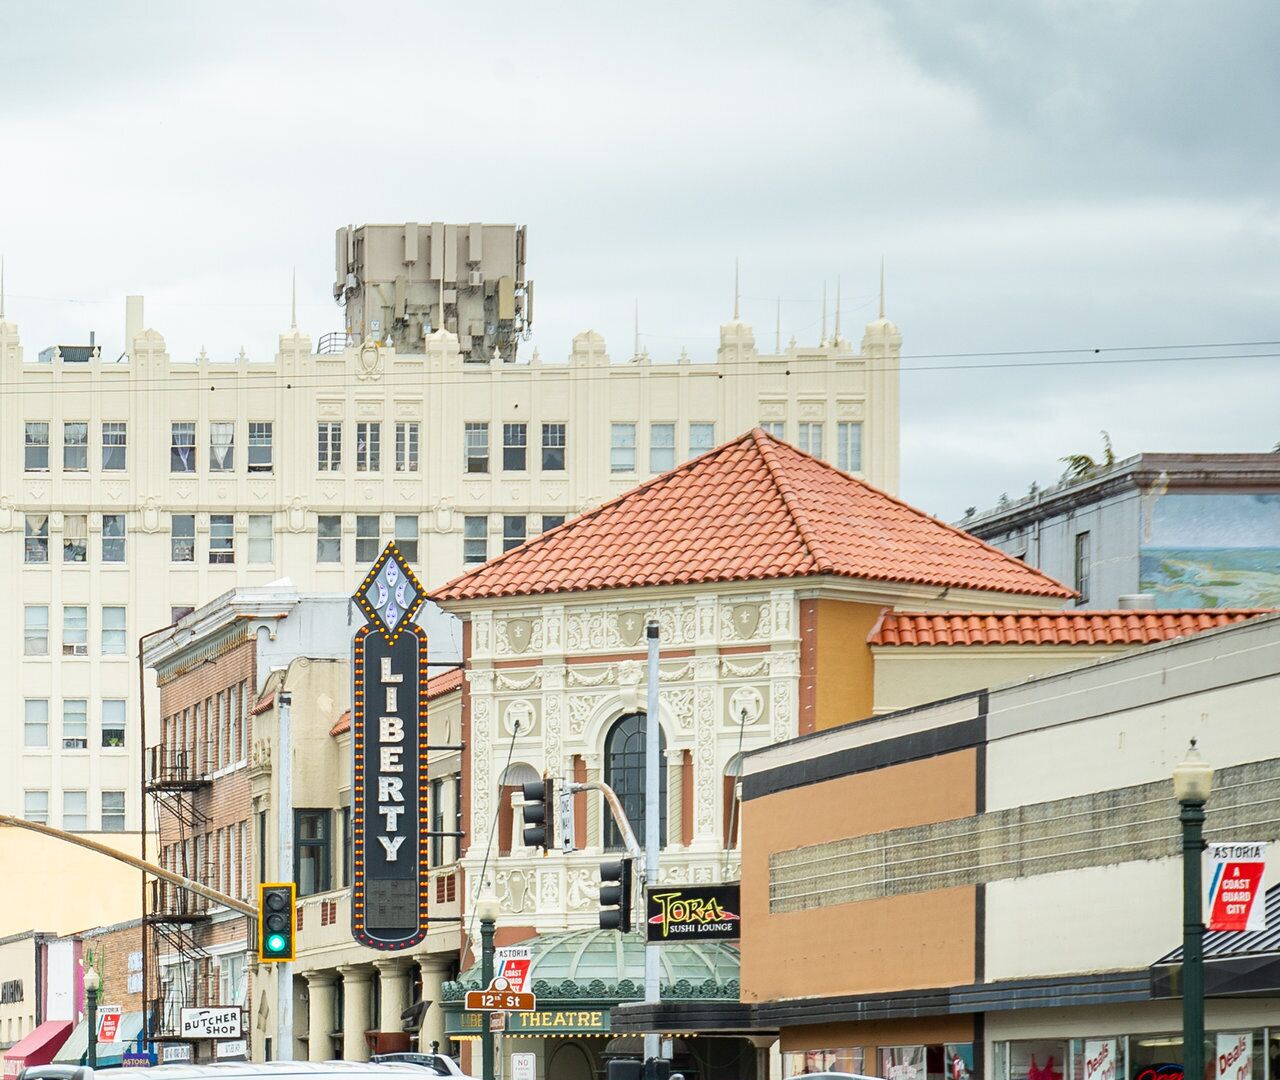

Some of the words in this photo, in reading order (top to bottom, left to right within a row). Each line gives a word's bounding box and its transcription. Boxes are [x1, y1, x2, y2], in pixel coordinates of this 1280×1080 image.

[378, 656, 406, 863] LIBERTY
[1213, 845, 1262, 859] ASTORIA
[1232, 866, 1240, 878] A
[1222, 878, 1251, 890] COAST
[1226, 903, 1247, 915] CITY
[669, 924, 695, 933] SUSHI
[697, 922, 733, 932] LOUNGE
[498, 949, 529, 958] ASTORIA
[506, 995, 521, 1007] St
[184, 1012, 237, 1031] BUTCHER
[519, 1011, 603, 1027] THEATRE
[206, 1025, 236, 1035] SHOP
[122, 1058, 150, 1066] ASTORIA
